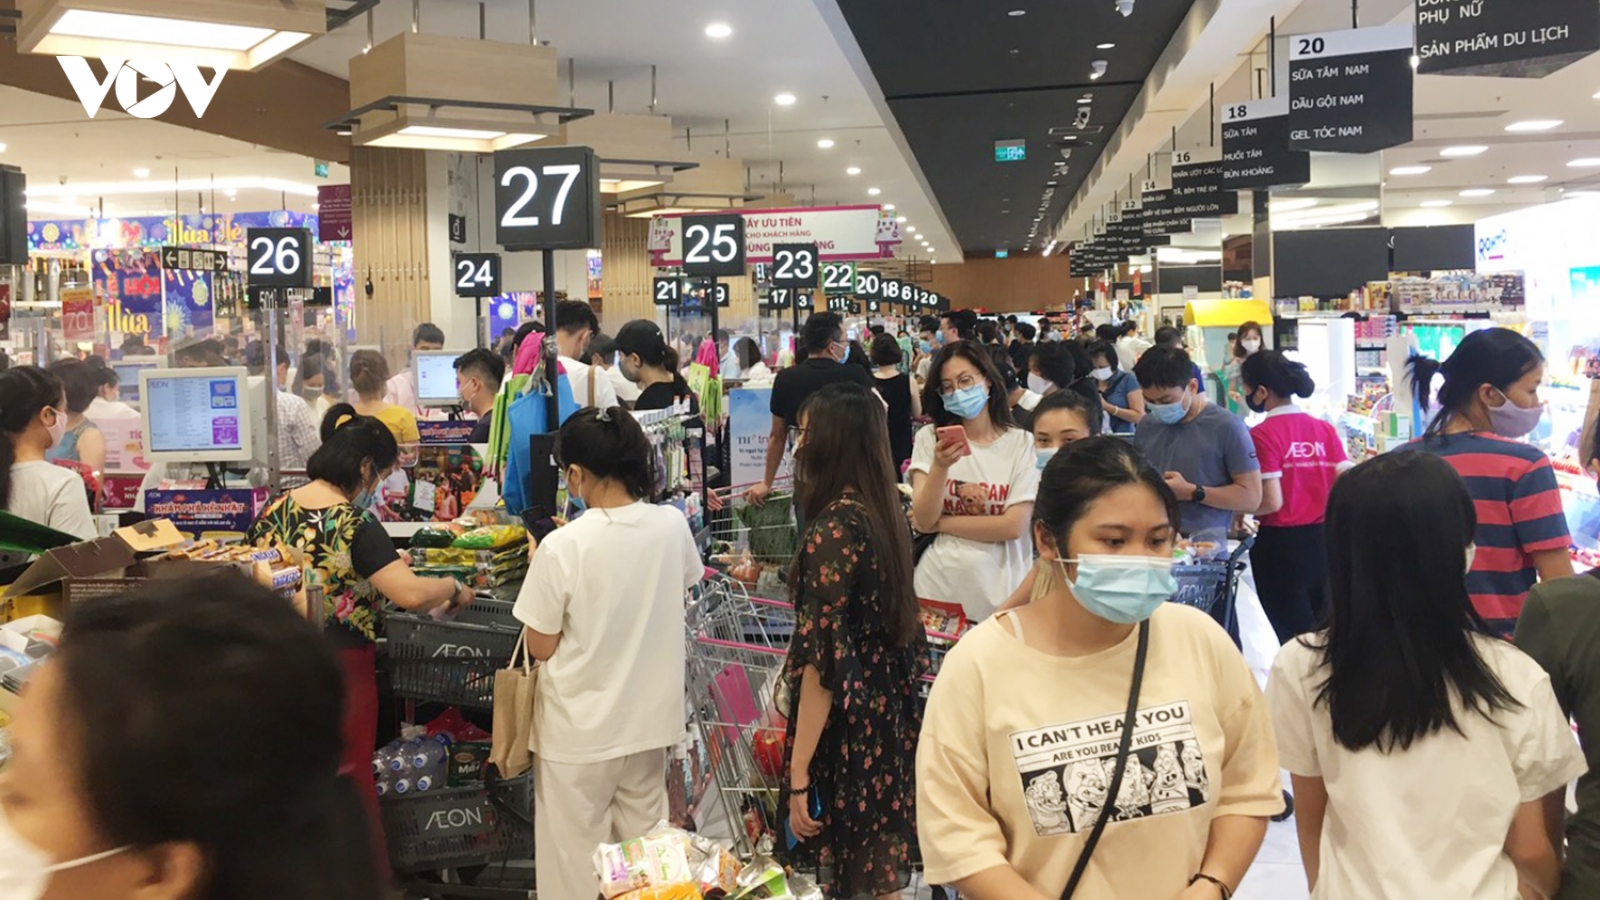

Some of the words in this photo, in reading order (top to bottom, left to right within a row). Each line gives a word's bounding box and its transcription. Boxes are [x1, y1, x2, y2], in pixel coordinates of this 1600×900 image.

[1419, 8, 1449, 24] PHỤ
[1460, 0, 1484, 18] NỮ
[1298, 37, 1324, 55] 20
[1420, 39, 1450, 58] SẢN
[1503, 31, 1526, 47] DU
[1531, 25, 1569, 44] LỊCH
[1291, 68, 1313, 81] SỮA
[1345, 64, 1369, 76] NAM
[1316, 94, 1337, 108] GỘI
[1340, 94, 1364, 106] NAM
[1228, 104, 1247, 119] 18
[1290, 129, 1311, 140] GEL
[1313, 125, 1336, 138] TÓC
[1338, 125, 1362, 137] NAM
[1177, 152, 1190, 163] 16
[1145, 181, 1156, 190] 14
[501, 164, 581, 227] 27
[780, 216, 802, 227] TIÊN
[685, 223, 738, 263] 25
[746, 242, 771, 253] ÙNG
[250, 236, 300, 275] 26
[774, 250, 814, 279] 23
[457, 260, 493, 288] 24
[823, 265, 852, 288] 22
[656, 281, 677, 300] 21
[856, 275, 879, 294] 20
[881, 281, 899, 298] 18
[771, 289, 788, 304] 17
[1017, 738, 1024, 750] I
[1027, 726, 1082, 748] CAN'T
[1142, 706, 1184, 725] YOU
[1052, 752, 1075, 763] ARE
[1075, 747, 1098, 757] YOU
[1136, 733, 1162, 744] KIDS
